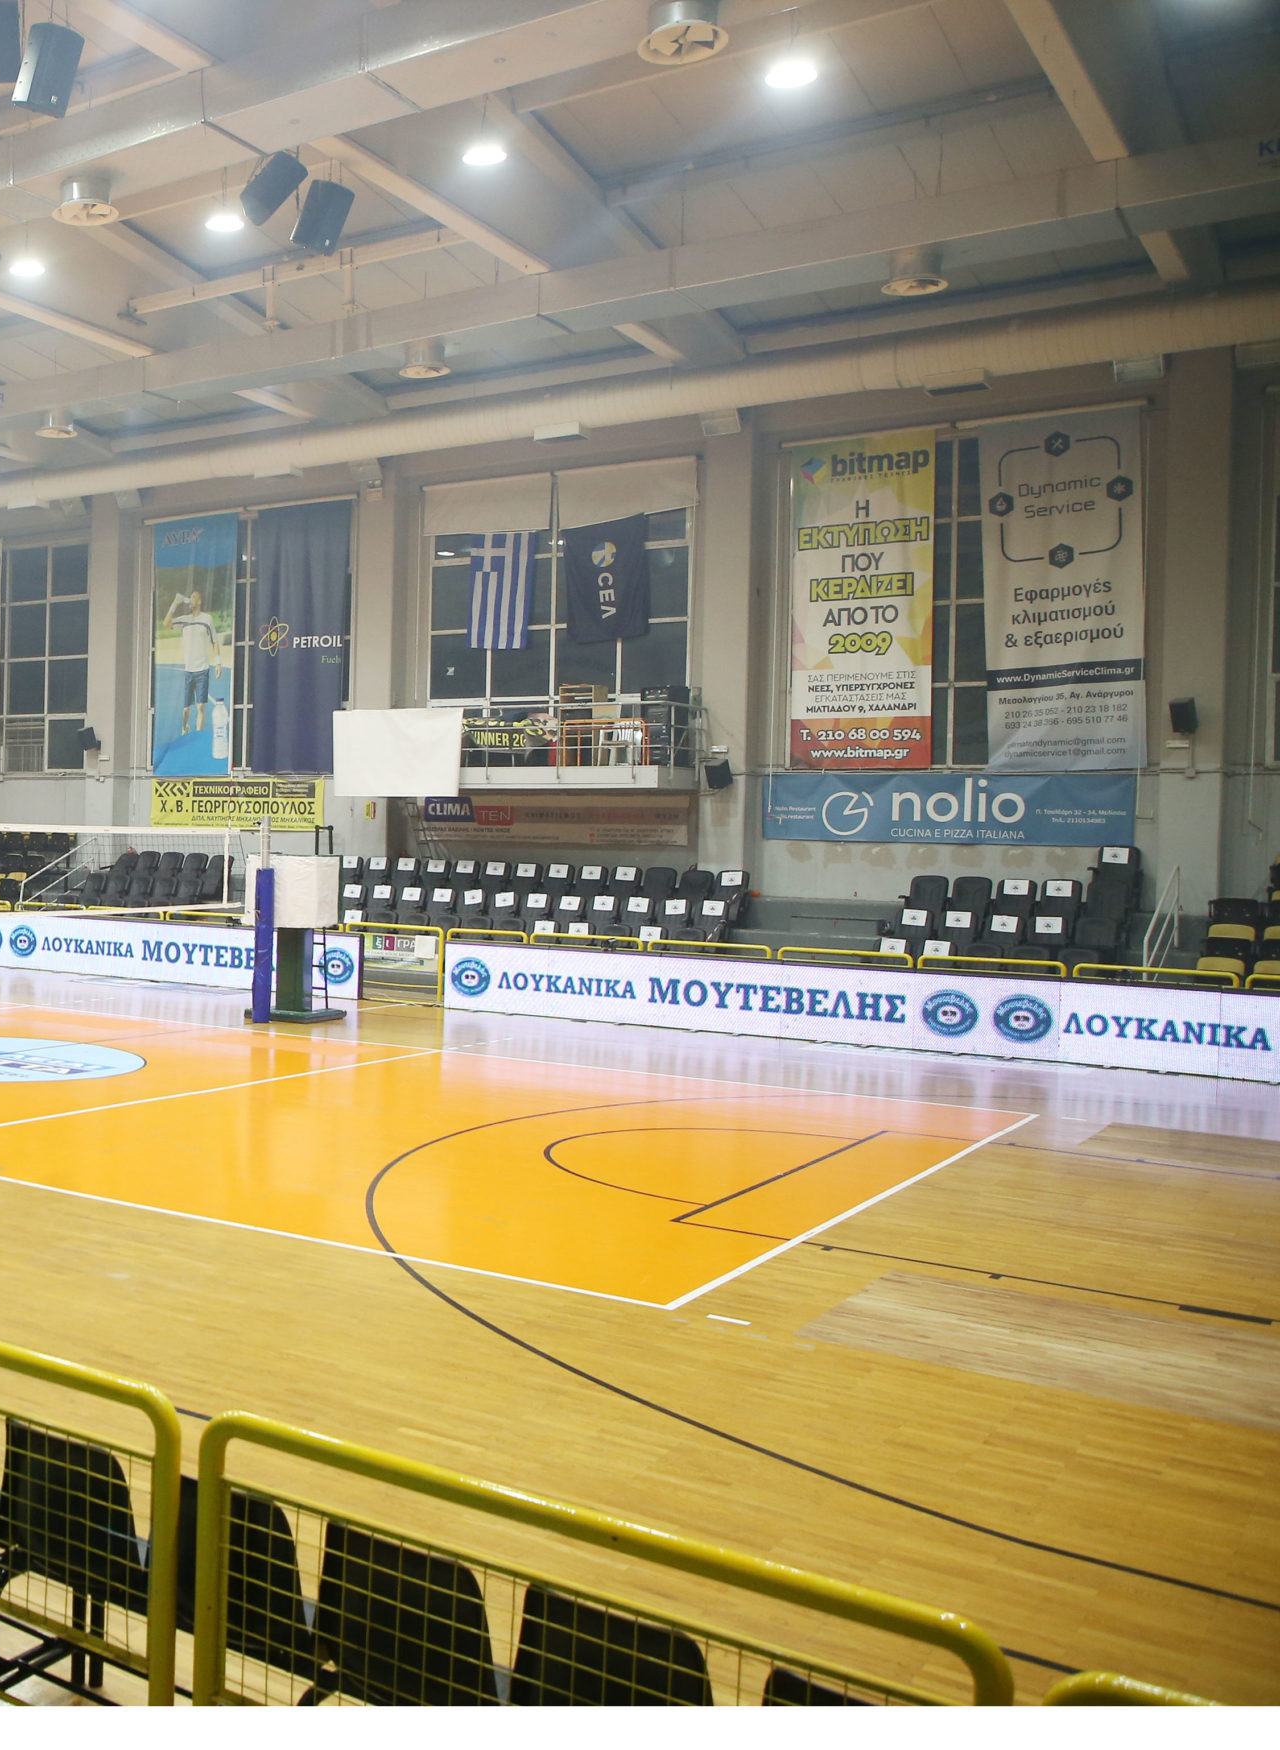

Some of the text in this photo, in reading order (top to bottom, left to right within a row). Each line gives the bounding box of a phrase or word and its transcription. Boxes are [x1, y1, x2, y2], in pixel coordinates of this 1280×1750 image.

[831, 449, 930, 477] bitmap
[1018, 475, 1101, 498] Dynamic
[855, 499, 870, 519] Η
[1024, 499, 1097, 519] Service
[798, 516, 930, 551] ΕΚΤΥΠΩΣΗ
[841, 551, 884, 574] ΠΟΥ
[809, 571, 914, 602] ΚΕΡΔΙΖΕΙ
[823, 604, 899, 628] ΑΠΟ ΤΟ
[1011, 600, 1116, 627] κλιματισμού
[293, 635, 343, 649] PETROIL
[828, 631, 893, 655] 2009
[1004, 622, 1125, 649] & εξαερισμού
[808, 670, 917, 683] ΣΑΣ ΠΕΡΙΜΕΝΟΥΜΕ ΣΤΙΣ
[996, 666, 1135, 684] www.DynamicServiceClima.gr
[808, 682, 915, 694] ΝΕΕΣ, ΥΠΕΡΣΥΓΧΡΟΝΕΣ
[815, 692, 907, 703] ΕΓΚΑΤΑΣΤΑΣΕΙΣ ΜΑΣ
[806, 704, 856, 713] ΜΙΛΤΙΑΔΟΥ
[868, 702, 917, 712] ΧΑΛΑΝΔΡΙ
[1004, 711, 1020, 719] 210
[1066, 706, 1083, 714] 210
[1085, 705, 1096, 713] 23
[1099, 704, 1109, 713] 18
[1066, 716, 1083, 725] 695
[1085, 716, 1102, 724] 510
[1104, 715, 1114, 723] 77
[817, 729, 845, 741] 210
[848, 727, 866, 741] 68
[869, 729, 890, 740] 00
[893, 728, 922, 741] 594
[810, 746, 910, 760] www.bitmap.gr
[193, 786, 230, 795] ΤΕΧΝΙΚΟ
[231, 786, 269, 796] ΓΡΑΦΕΙΟ
[891, 777, 1026, 823] nolio
[427, 803, 510, 822] CLIMA TEN
[890, 828, 1025, 840] CUCINA E PIZZA ITALIANA
[397, 939, 416, 949] ΓΡΑ
[41, 937, 275, 972] ΛΟΥΚΑΝΙΚΑ ΜΟΥΤΕΒΕ
[497, 971, 906, 1024] ΛΟΥΚΑΝΙΚΑ ΜΟΥΤΕΒΕΛΗΣ
[1062, 1012, 1272, 1051] ΛΟΥΚΑΝΙΚΑ
